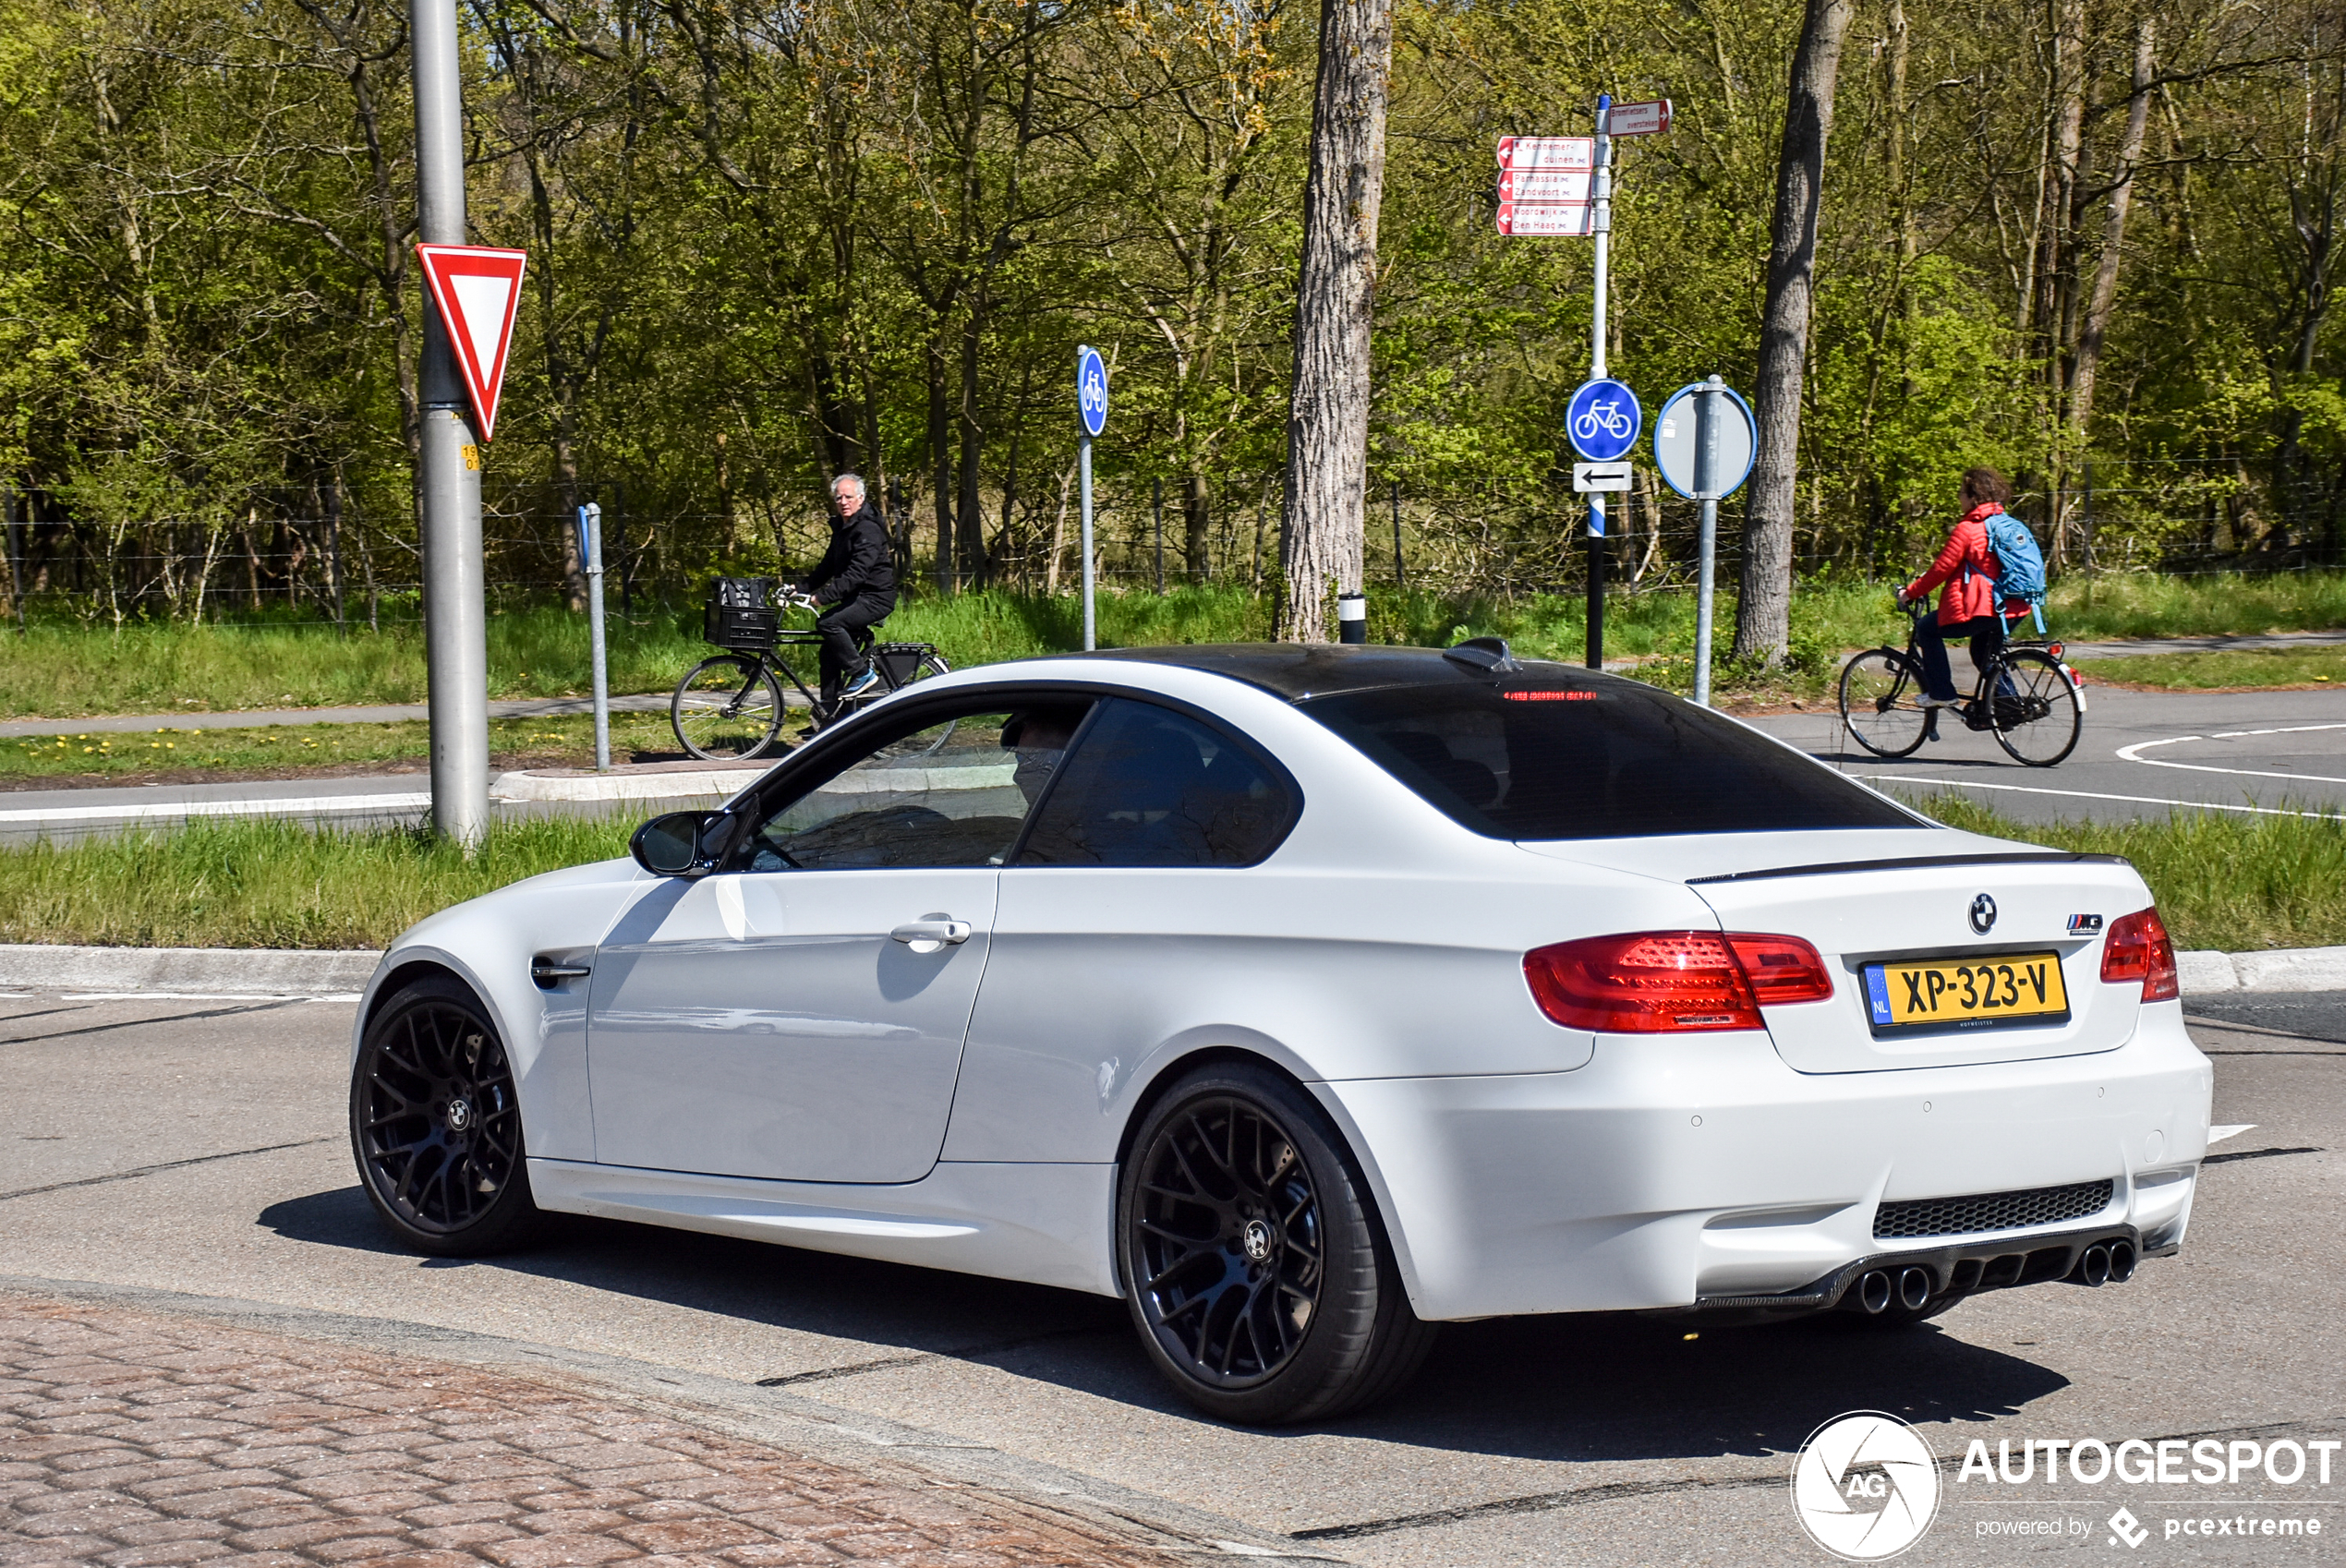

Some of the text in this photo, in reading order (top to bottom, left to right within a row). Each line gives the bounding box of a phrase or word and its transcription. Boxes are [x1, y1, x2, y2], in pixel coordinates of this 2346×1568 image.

[1525, 142, 1574, 151] Kennemer-
[1515, 175, 1558, 183] Parnassia
[1515, 187, 1560, 196] Zandvoort
[1514, 208, 1557, 218] Noordwijk
[1533, 222, 1555, 231] Haag
[463, 446, 477, 456] 19
[1901, 963, 2047, 1014] XP-323-V
[1873, 1000, 1889, 1014] NL
